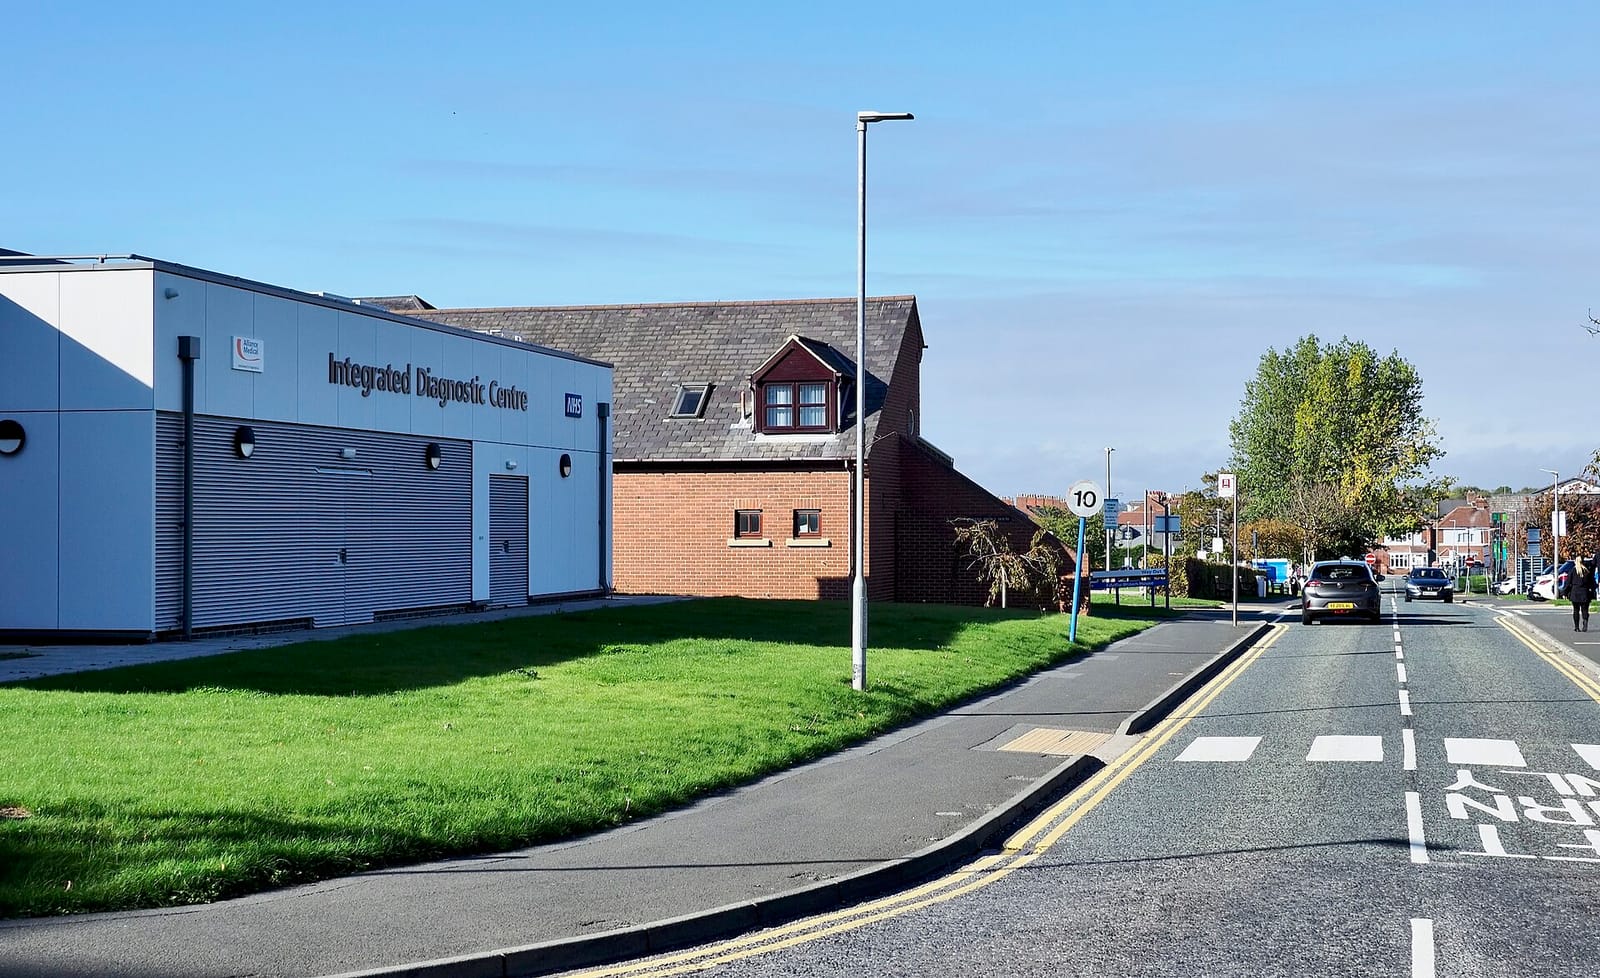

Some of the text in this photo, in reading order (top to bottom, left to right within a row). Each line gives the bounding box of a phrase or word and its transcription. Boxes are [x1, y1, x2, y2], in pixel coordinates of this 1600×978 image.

[328, 352, 528, 411] Integrated Diagnostic Centre
[566, 396, 582, 414] NHS
[1073, 490, 1096, 508] 10
